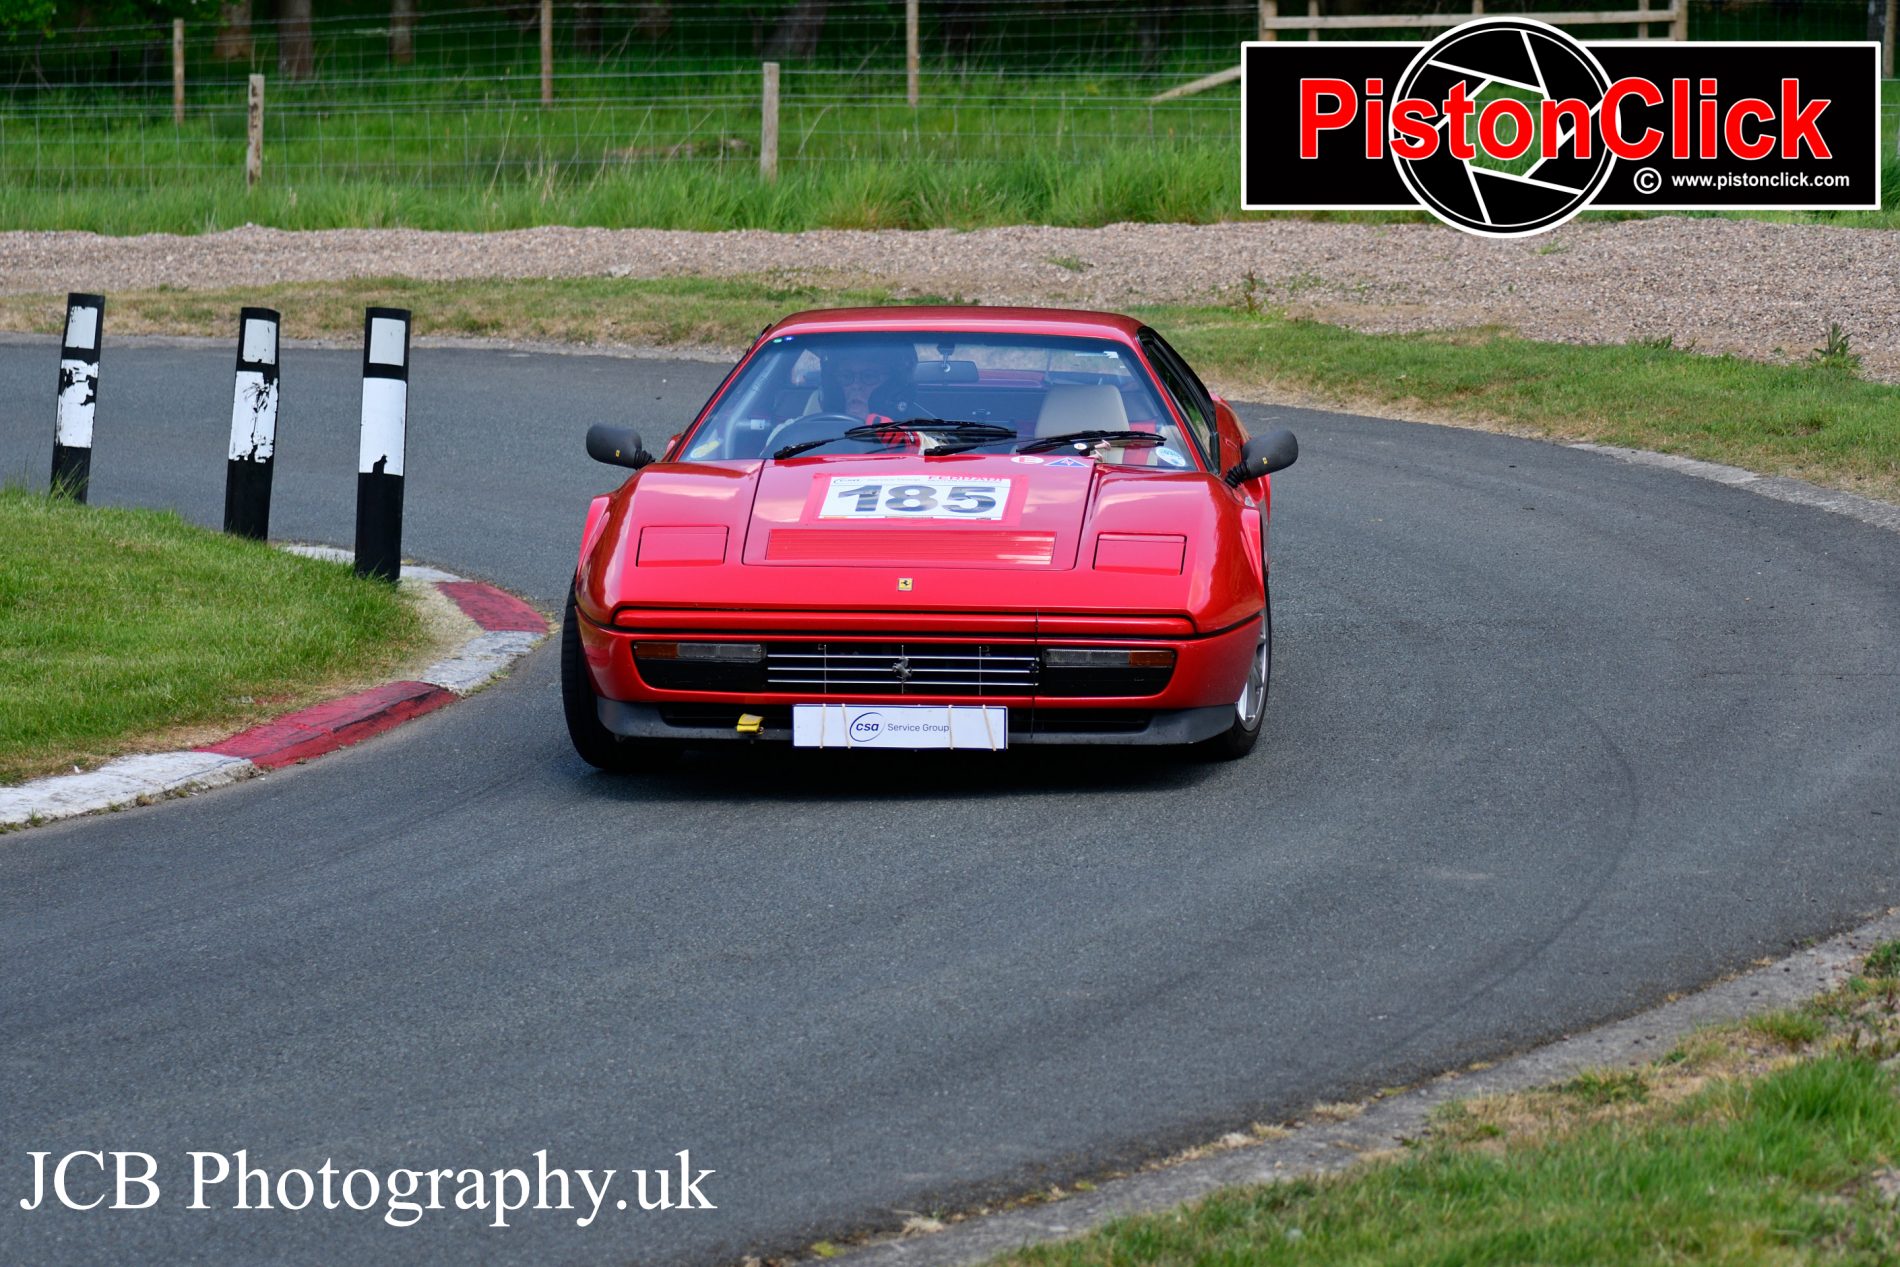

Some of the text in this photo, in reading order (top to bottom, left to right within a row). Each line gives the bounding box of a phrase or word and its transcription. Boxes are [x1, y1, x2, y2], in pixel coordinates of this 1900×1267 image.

[838, 485, 996, 514] 185
[855, 723, 950, 733] csa Service Group
